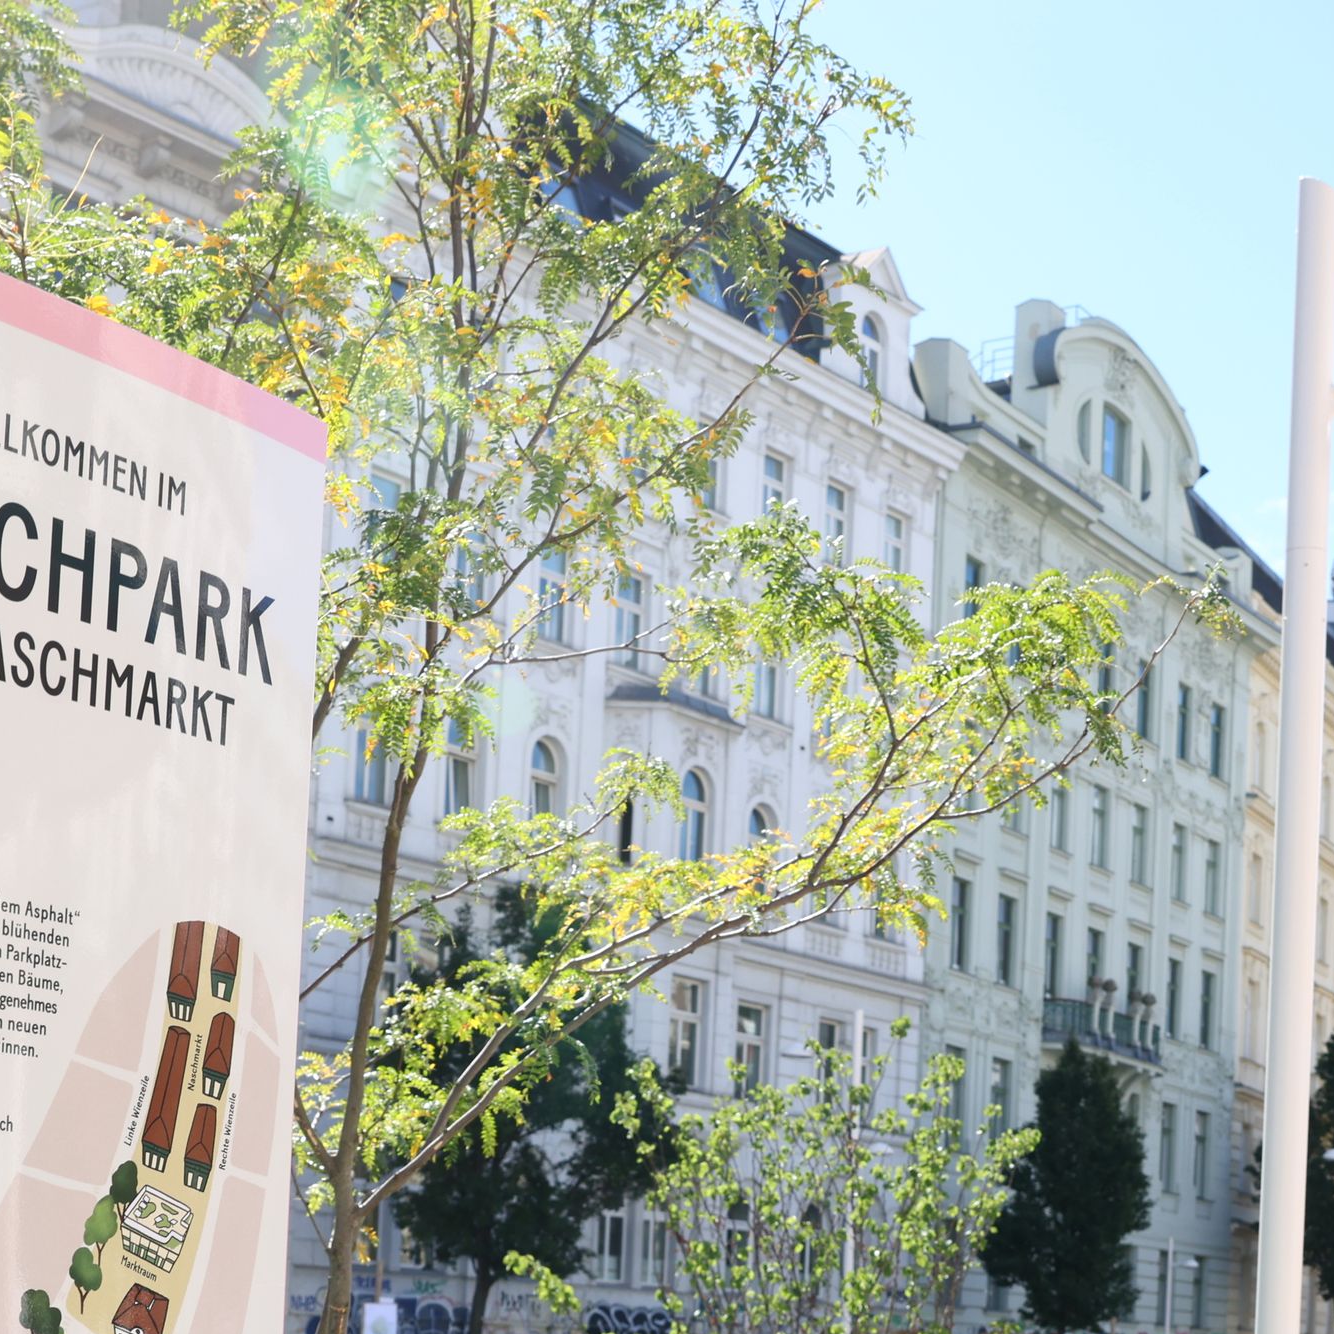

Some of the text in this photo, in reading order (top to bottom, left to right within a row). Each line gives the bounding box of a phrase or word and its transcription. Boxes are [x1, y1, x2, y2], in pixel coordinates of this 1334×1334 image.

[158, 472, 187, 516] IM
[2, 918, 70, 947] blühenden
[6, 943, 67, 969] Parkplatz-
[18, 969, 63, 995] Bäume,
[7, 1019, 47, 1036] neuen
[187, 1034, 203, 1091] Naschmarkt
[124, 1075, 150, 1146] Linke Wienzeile
[219, 1092, 237, 1171] Rechte Wienzeile
[120, 1256, 157, 1282] Marktraum
